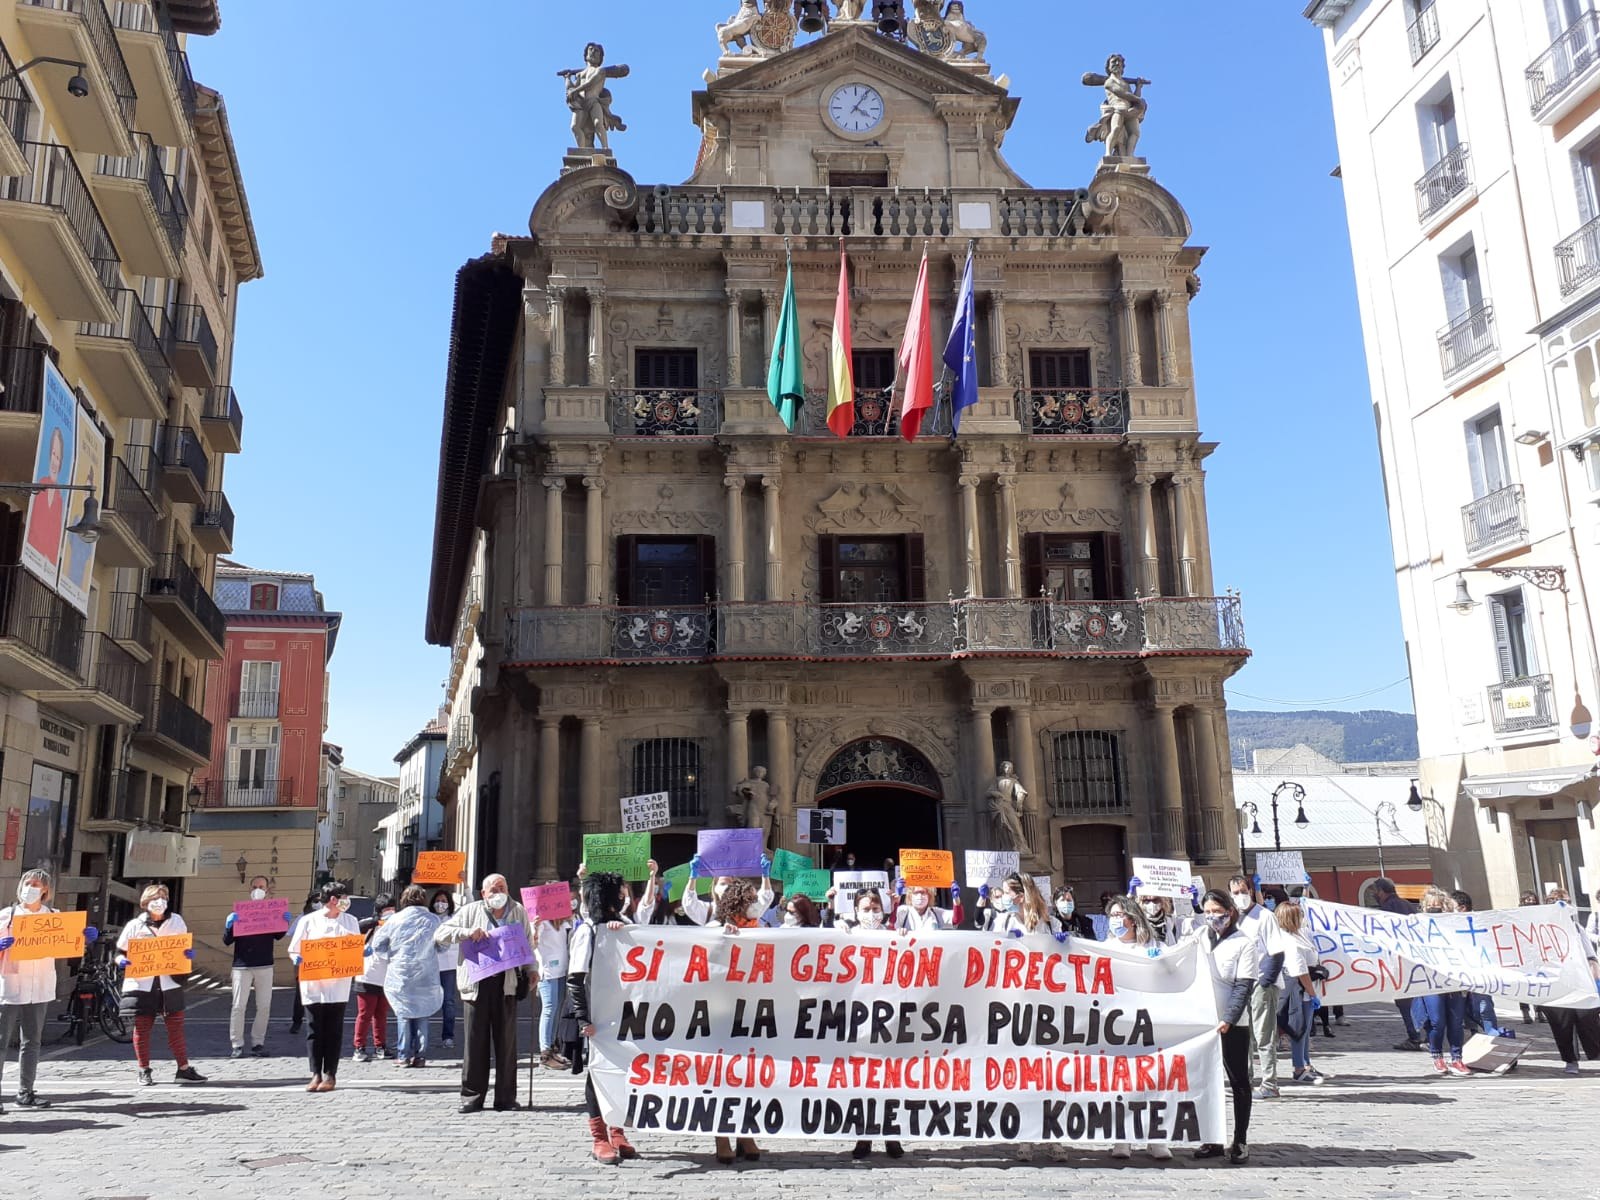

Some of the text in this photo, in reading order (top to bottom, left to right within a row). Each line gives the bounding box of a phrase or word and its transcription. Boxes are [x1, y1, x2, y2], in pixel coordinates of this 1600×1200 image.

[644, 811, 665, 820] SAD
[1265, 870, 1297, 880] HANDIA
[34, 917, 62, 930] SAD
[1308, 907, 1450, 945] NAVARRA
[162, 950, 174, 960] ES
[683, 944, 709, 983] A
[725, 943, 775, 983] LA
[790, 938, 943, 989] GESTIÓN
[964, 940, 1115, 995] DIRECTA
[1321, 955, 1403, 997] PSN
[617, 998, 1155, 1047] NO A LA EMPRESA PUBLICA
[628, 1048, 1189, 1092] SERVICIO DE ATENCIÓN DOMICILIARIA
[624, 1088, 1201, 1142] IRUÑEKO UDALETXEKO KOMITEA
